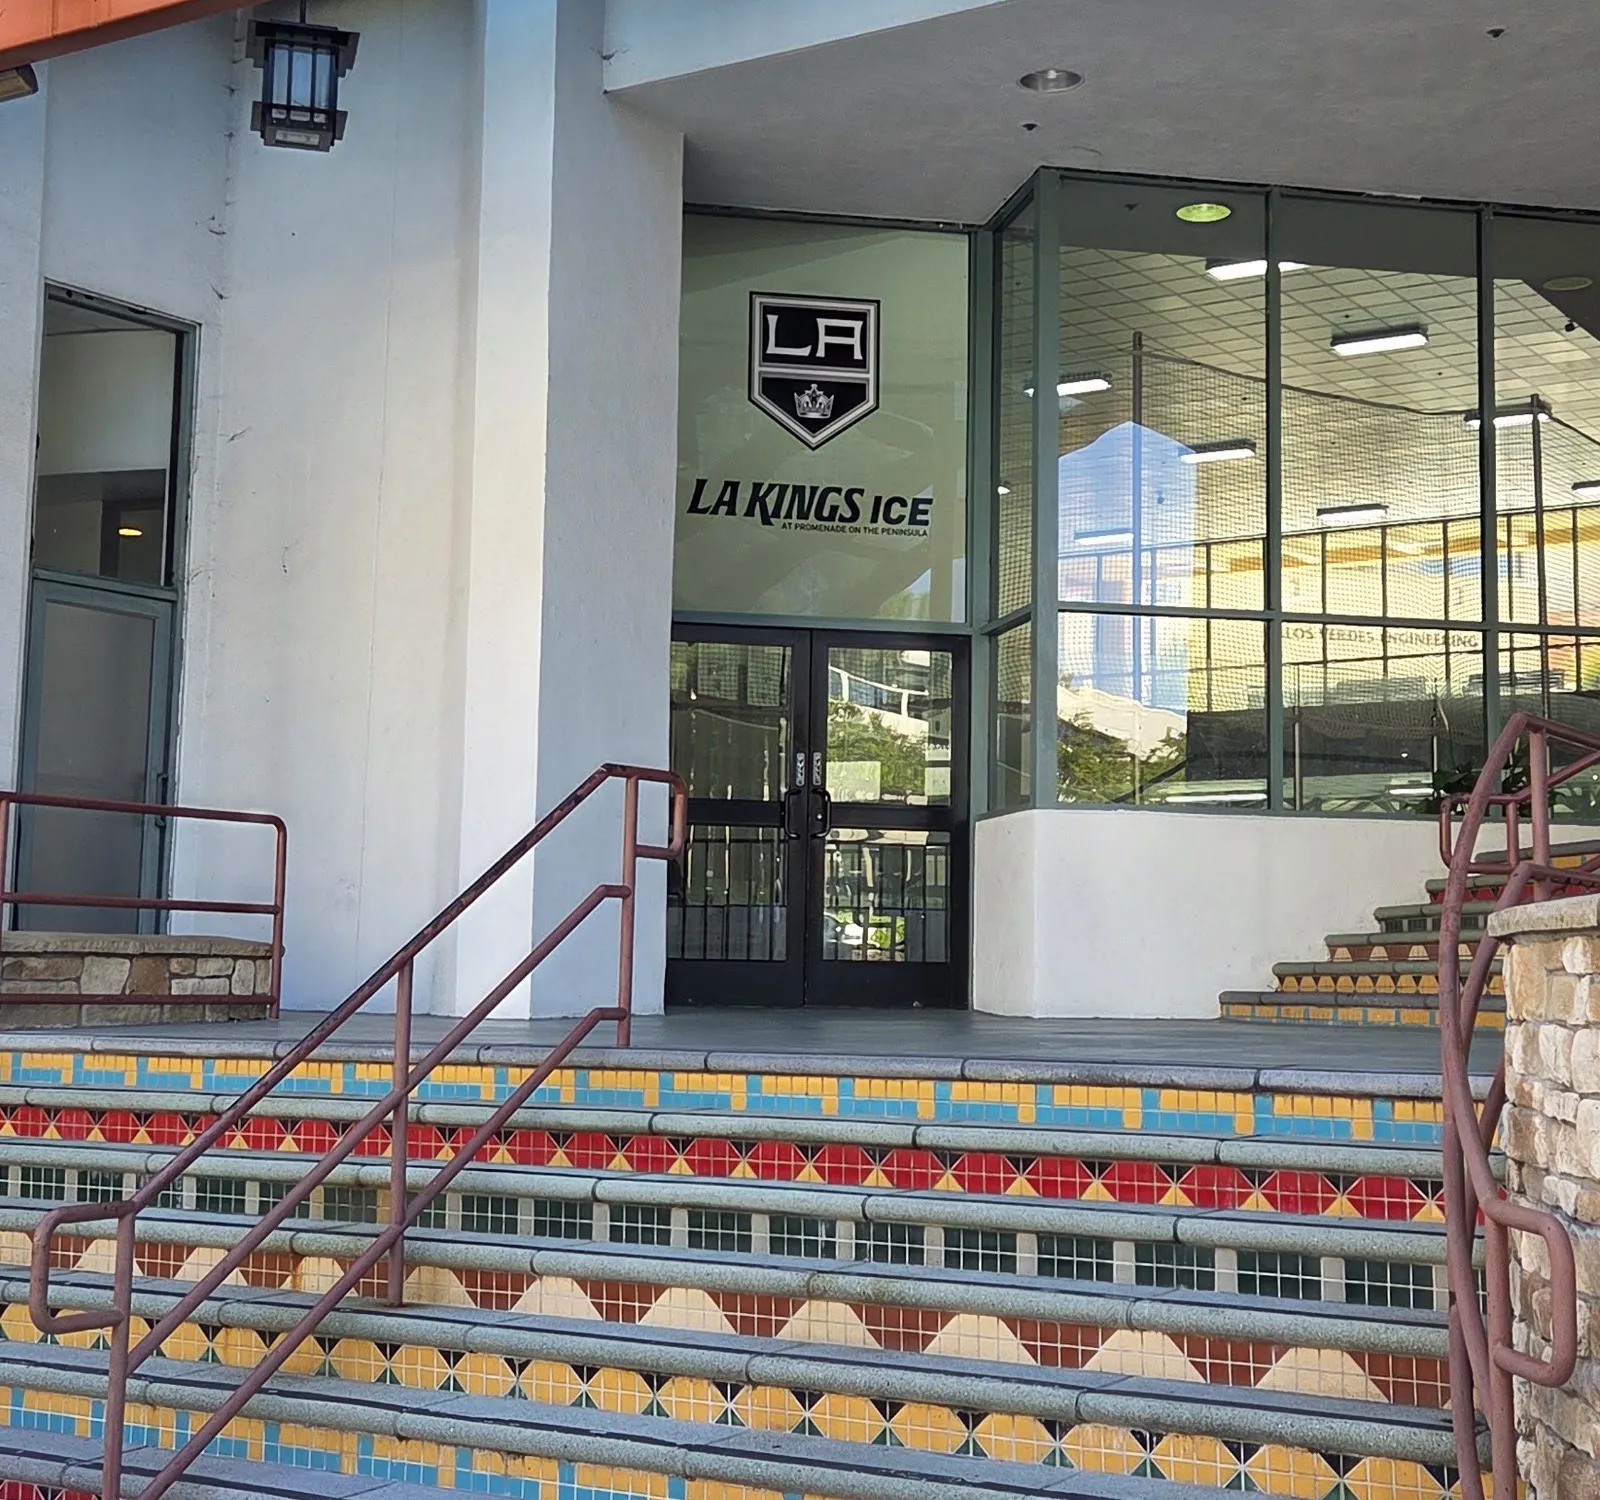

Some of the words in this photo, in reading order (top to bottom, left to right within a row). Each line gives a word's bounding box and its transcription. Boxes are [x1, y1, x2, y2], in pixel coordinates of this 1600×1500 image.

[765, 313, 864, 360] LA
[686, 478, 740, 516] LA
[743, 481, 865, 526] KINGS
[869, 495, 934, 526] ICE
[781, 522, 792, 531] AT
[794, 523, 847, 534] PROMENADE
[848, 526, 862, 534] ON
[863, 527, 879, 535] THE
[881, 528, 929, 537] PENINSULA
[1319, 627, 1375, 643] ERDES
[1381, 630, 1479, 648] NGINEEING
